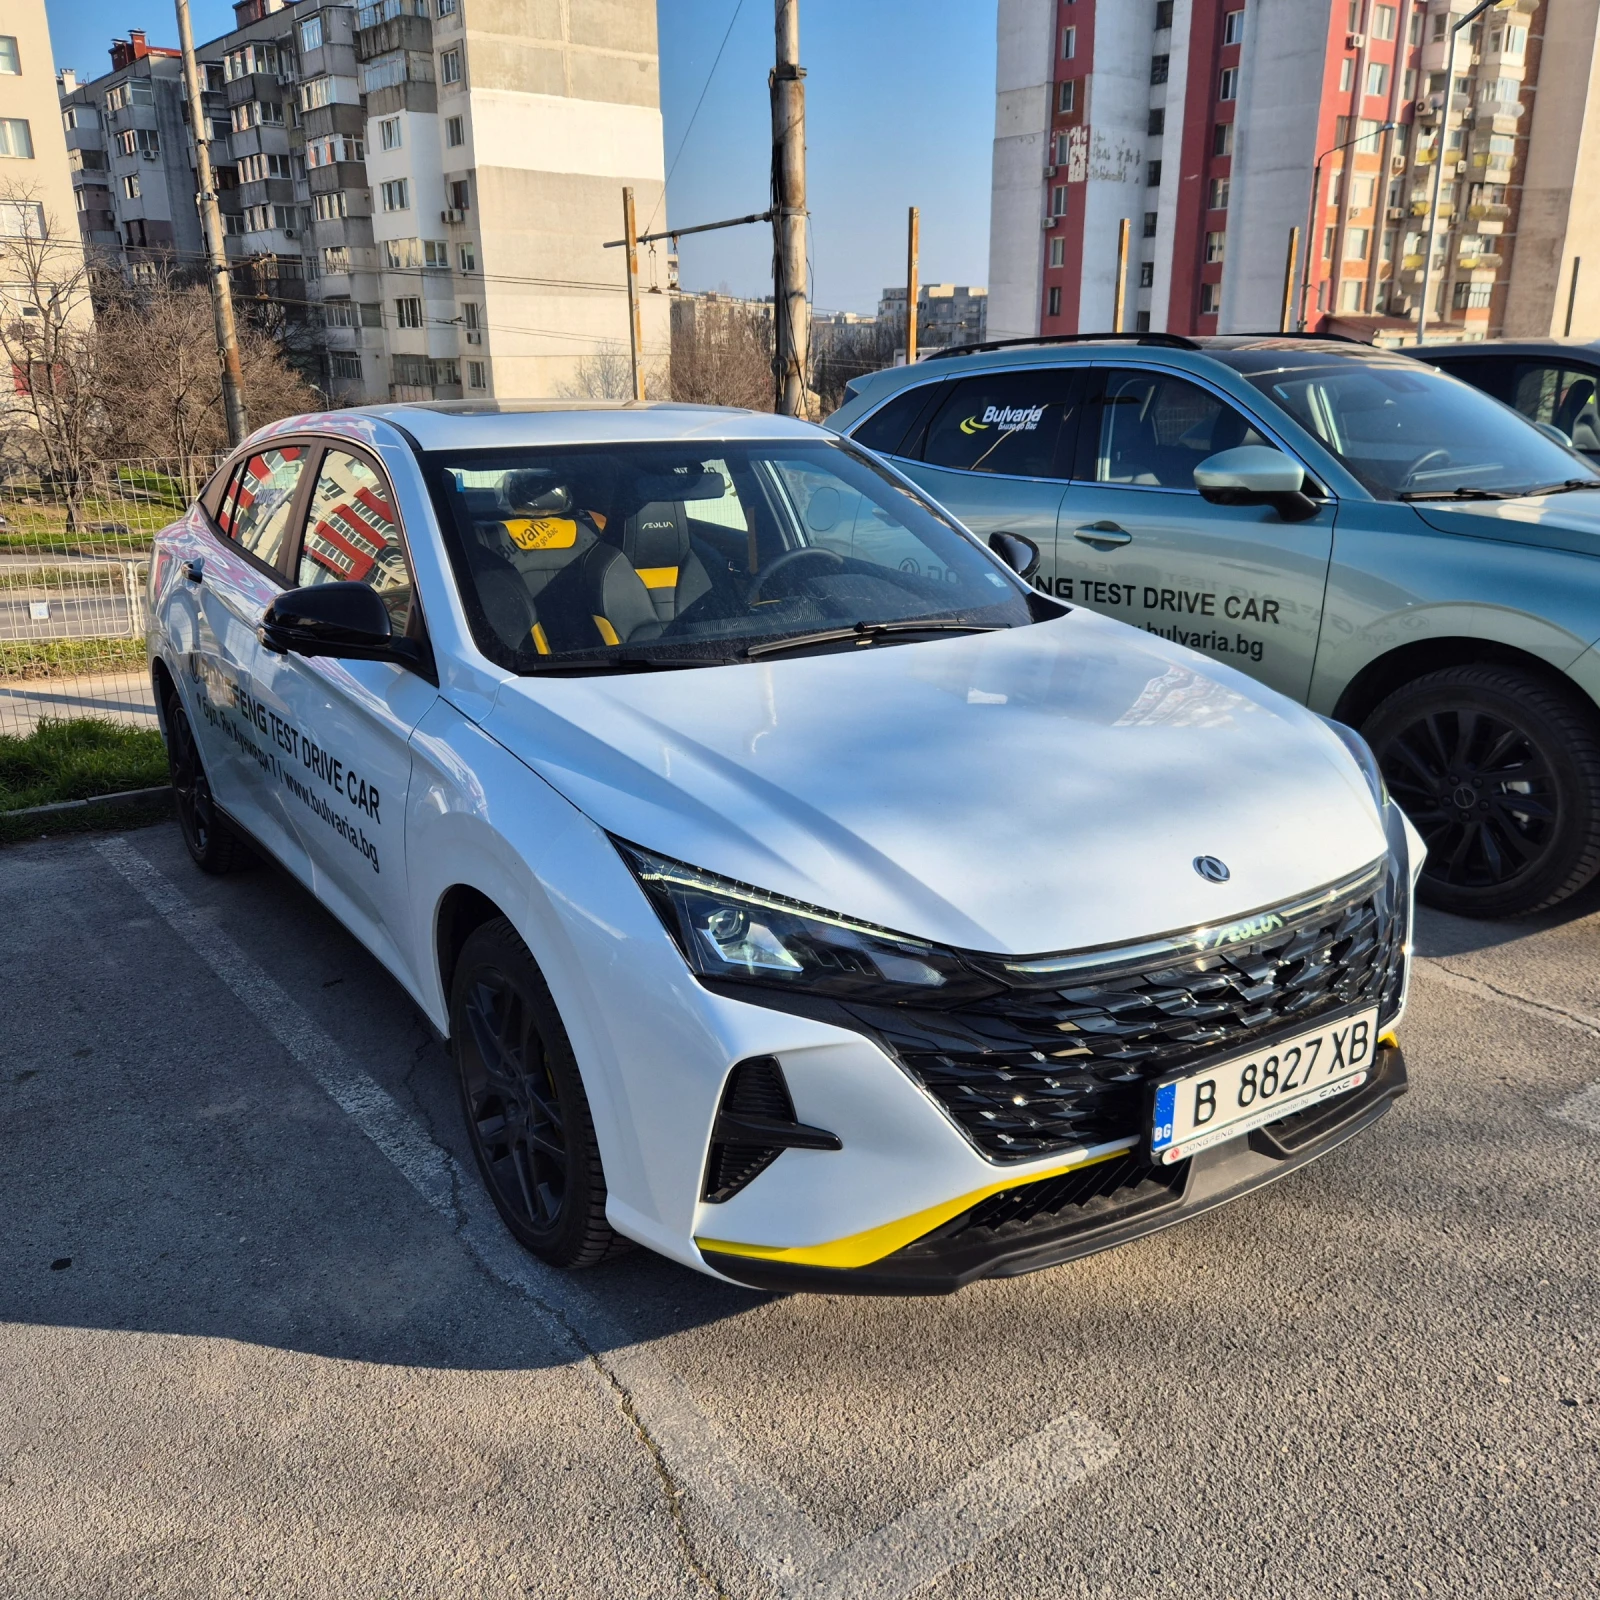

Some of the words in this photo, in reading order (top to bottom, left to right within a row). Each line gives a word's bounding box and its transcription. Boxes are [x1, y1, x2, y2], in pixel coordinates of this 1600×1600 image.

[982, 404, 1043, 423] Bulvaria
[1029, 575, 1073, 600] NG
[1080, 580, 1136, 606] TEST
[1143, 587, 1216, 617] DRIVE
[1223, 595, 1280, 625] CAR
[269, 712, 299, 760] TEST
[301, 735, 344, 795] DRIVE
[346, 770, 381, 825] CAR
[268, 753, 277, 777] 7
[283, 769, 380, 874] www.bulvaria.bg
[1193, 1079, 1217, 1128] B
[1236, 1037, 1323, 1108] 8827
[1327, 1020, 1369, 1075] XB
[1154, 1123, 1173, 1142] BG
[1182, 1127, 1234, 1155] DONGFENG
